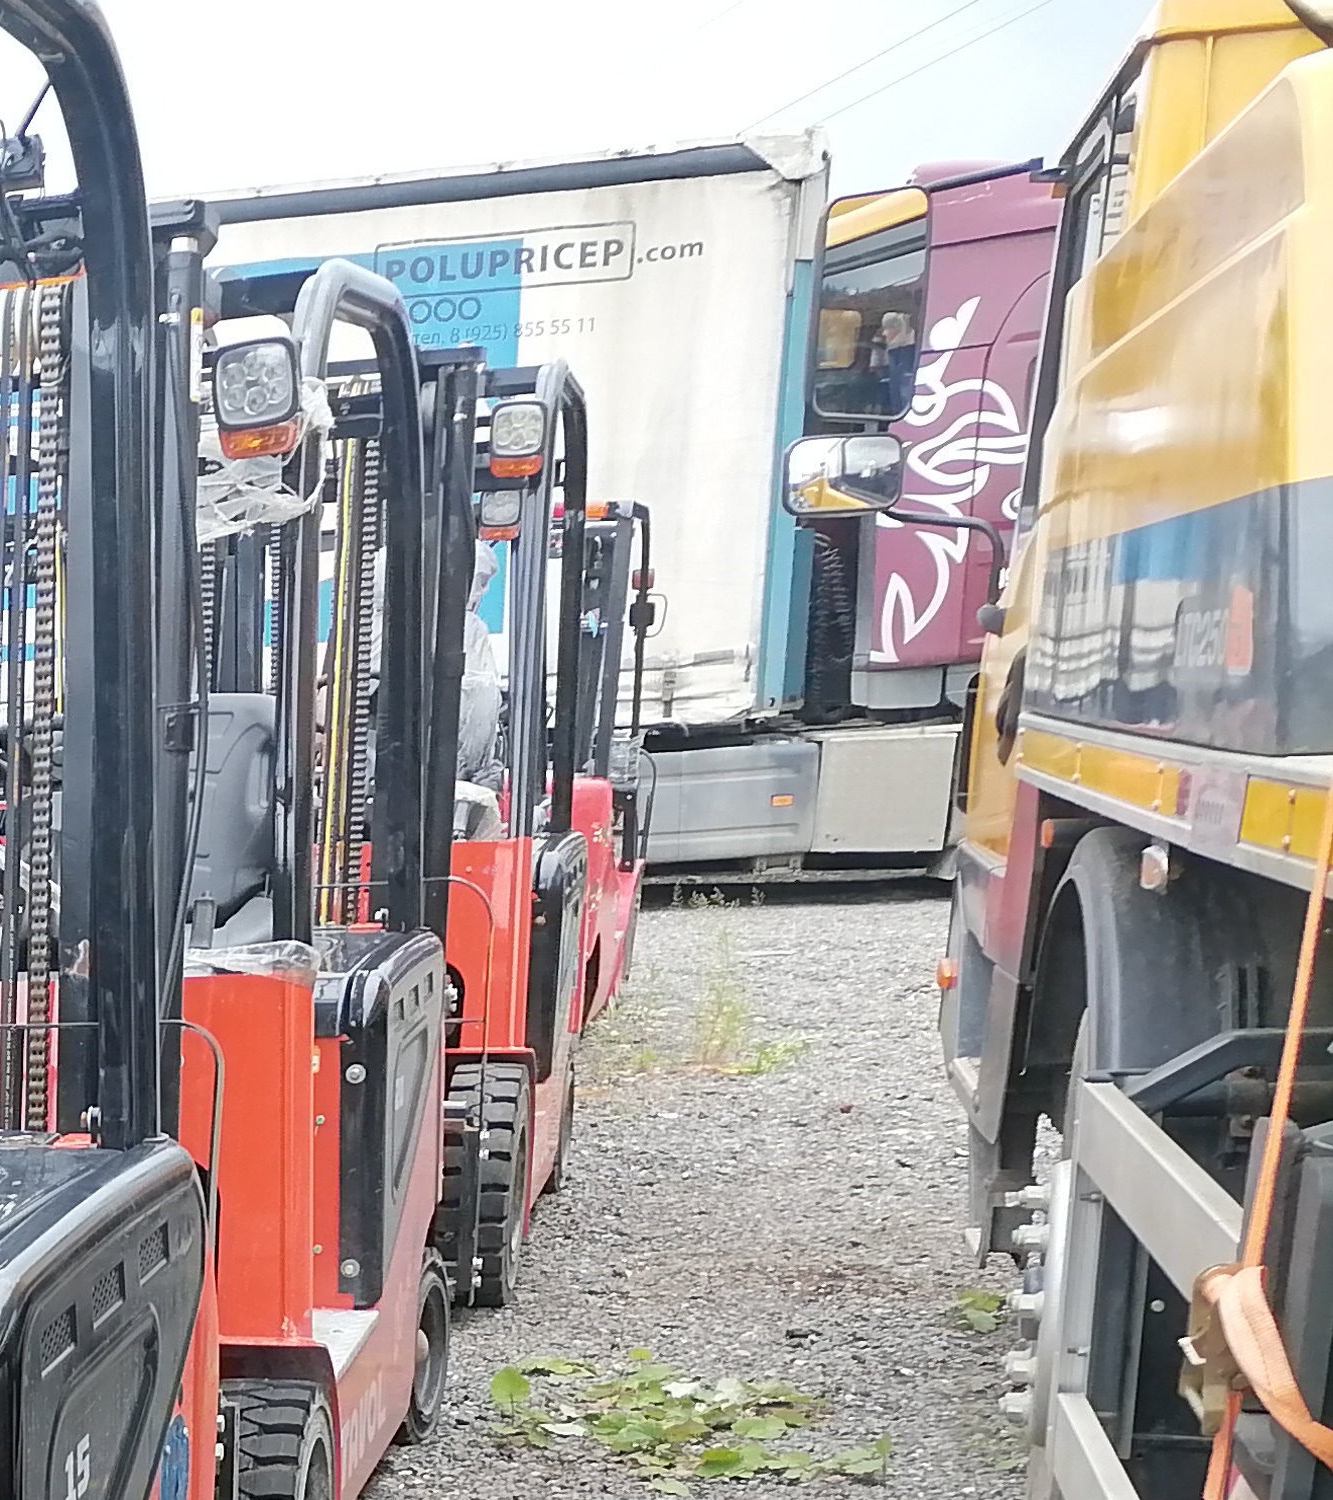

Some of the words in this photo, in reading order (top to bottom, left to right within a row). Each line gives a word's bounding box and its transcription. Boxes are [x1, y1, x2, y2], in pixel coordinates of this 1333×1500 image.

[385, 238, 624, 284] POLUPRICEP
[450, 327, 460, 343] 8
[514, 320, 545, 337] 855
[549, 318, 571, 335] 55
[577, 316, 596, 333] 11
